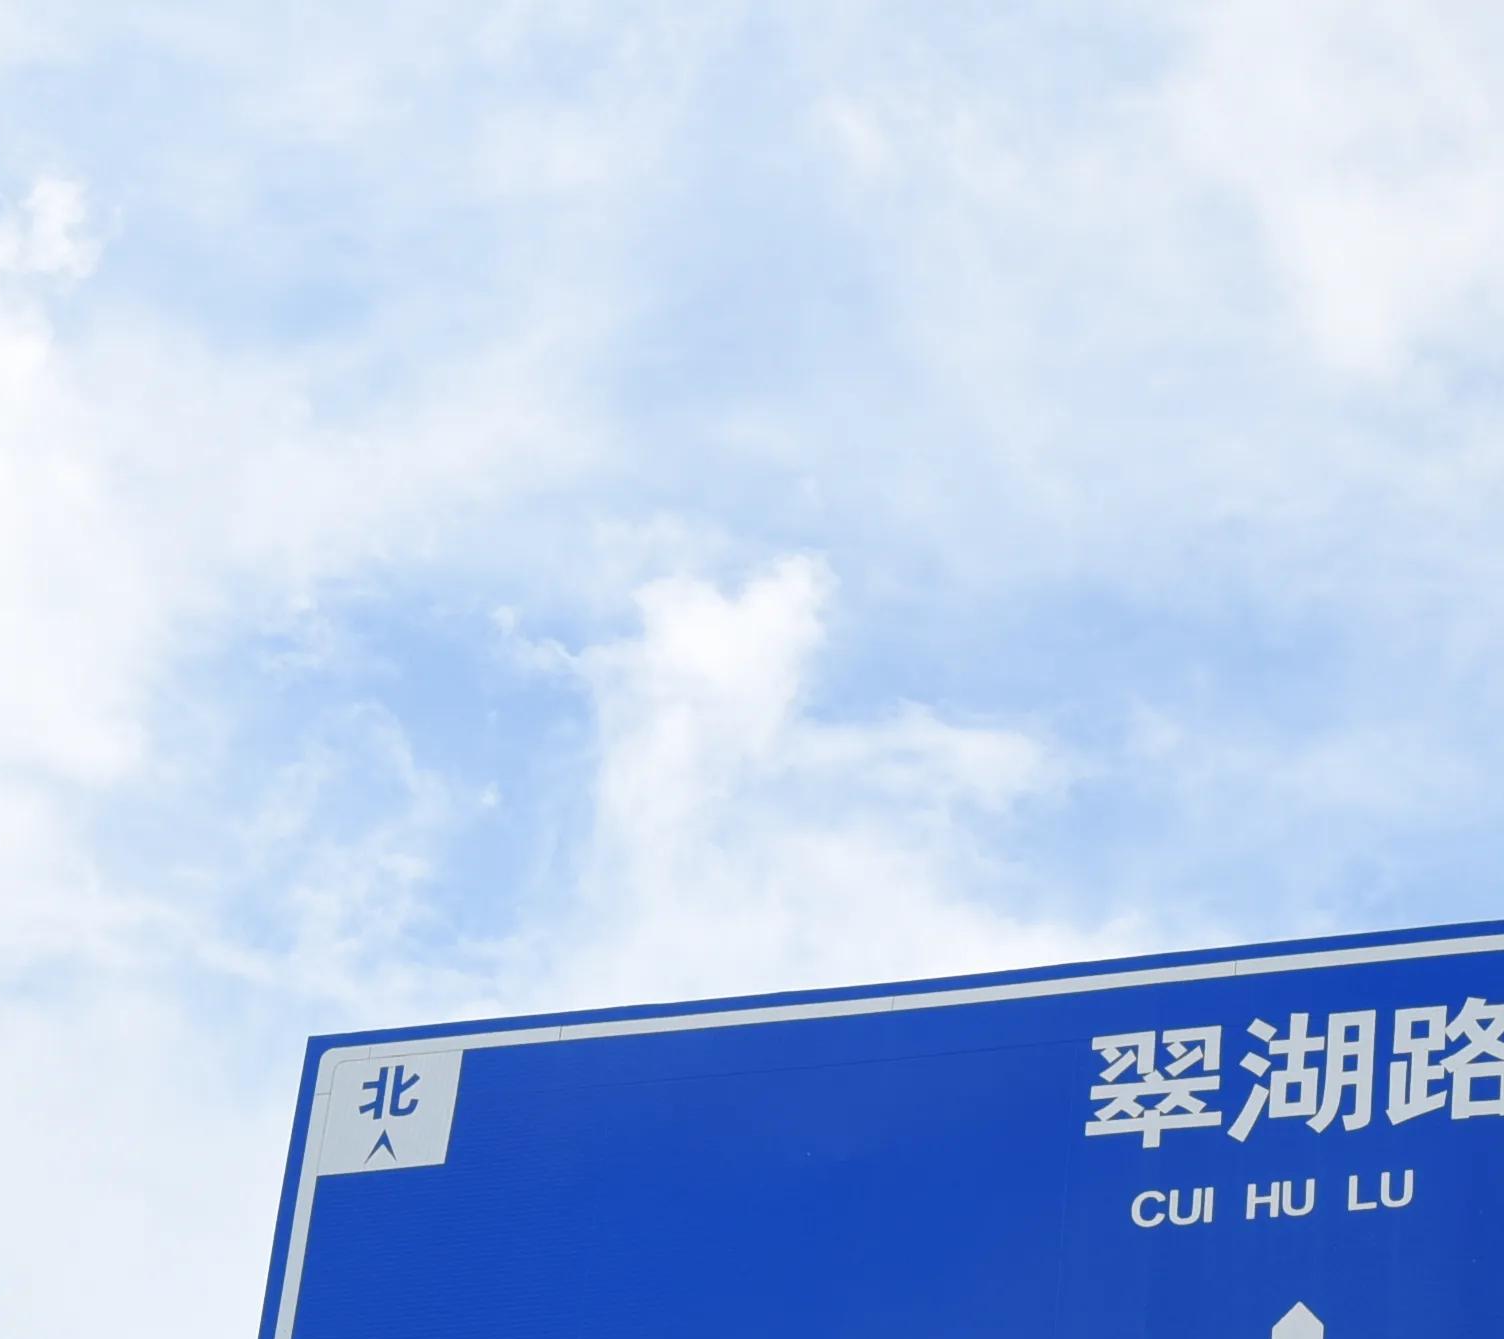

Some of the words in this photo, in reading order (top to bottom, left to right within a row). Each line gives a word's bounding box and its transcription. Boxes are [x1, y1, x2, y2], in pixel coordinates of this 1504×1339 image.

[358, 1064, 421, 1124] 北
[1130, 1185, 1216, 1229] CUI
[1244, 1177, 1317, 1221] HU
[1346, 1168, 1415, 1213] LU
